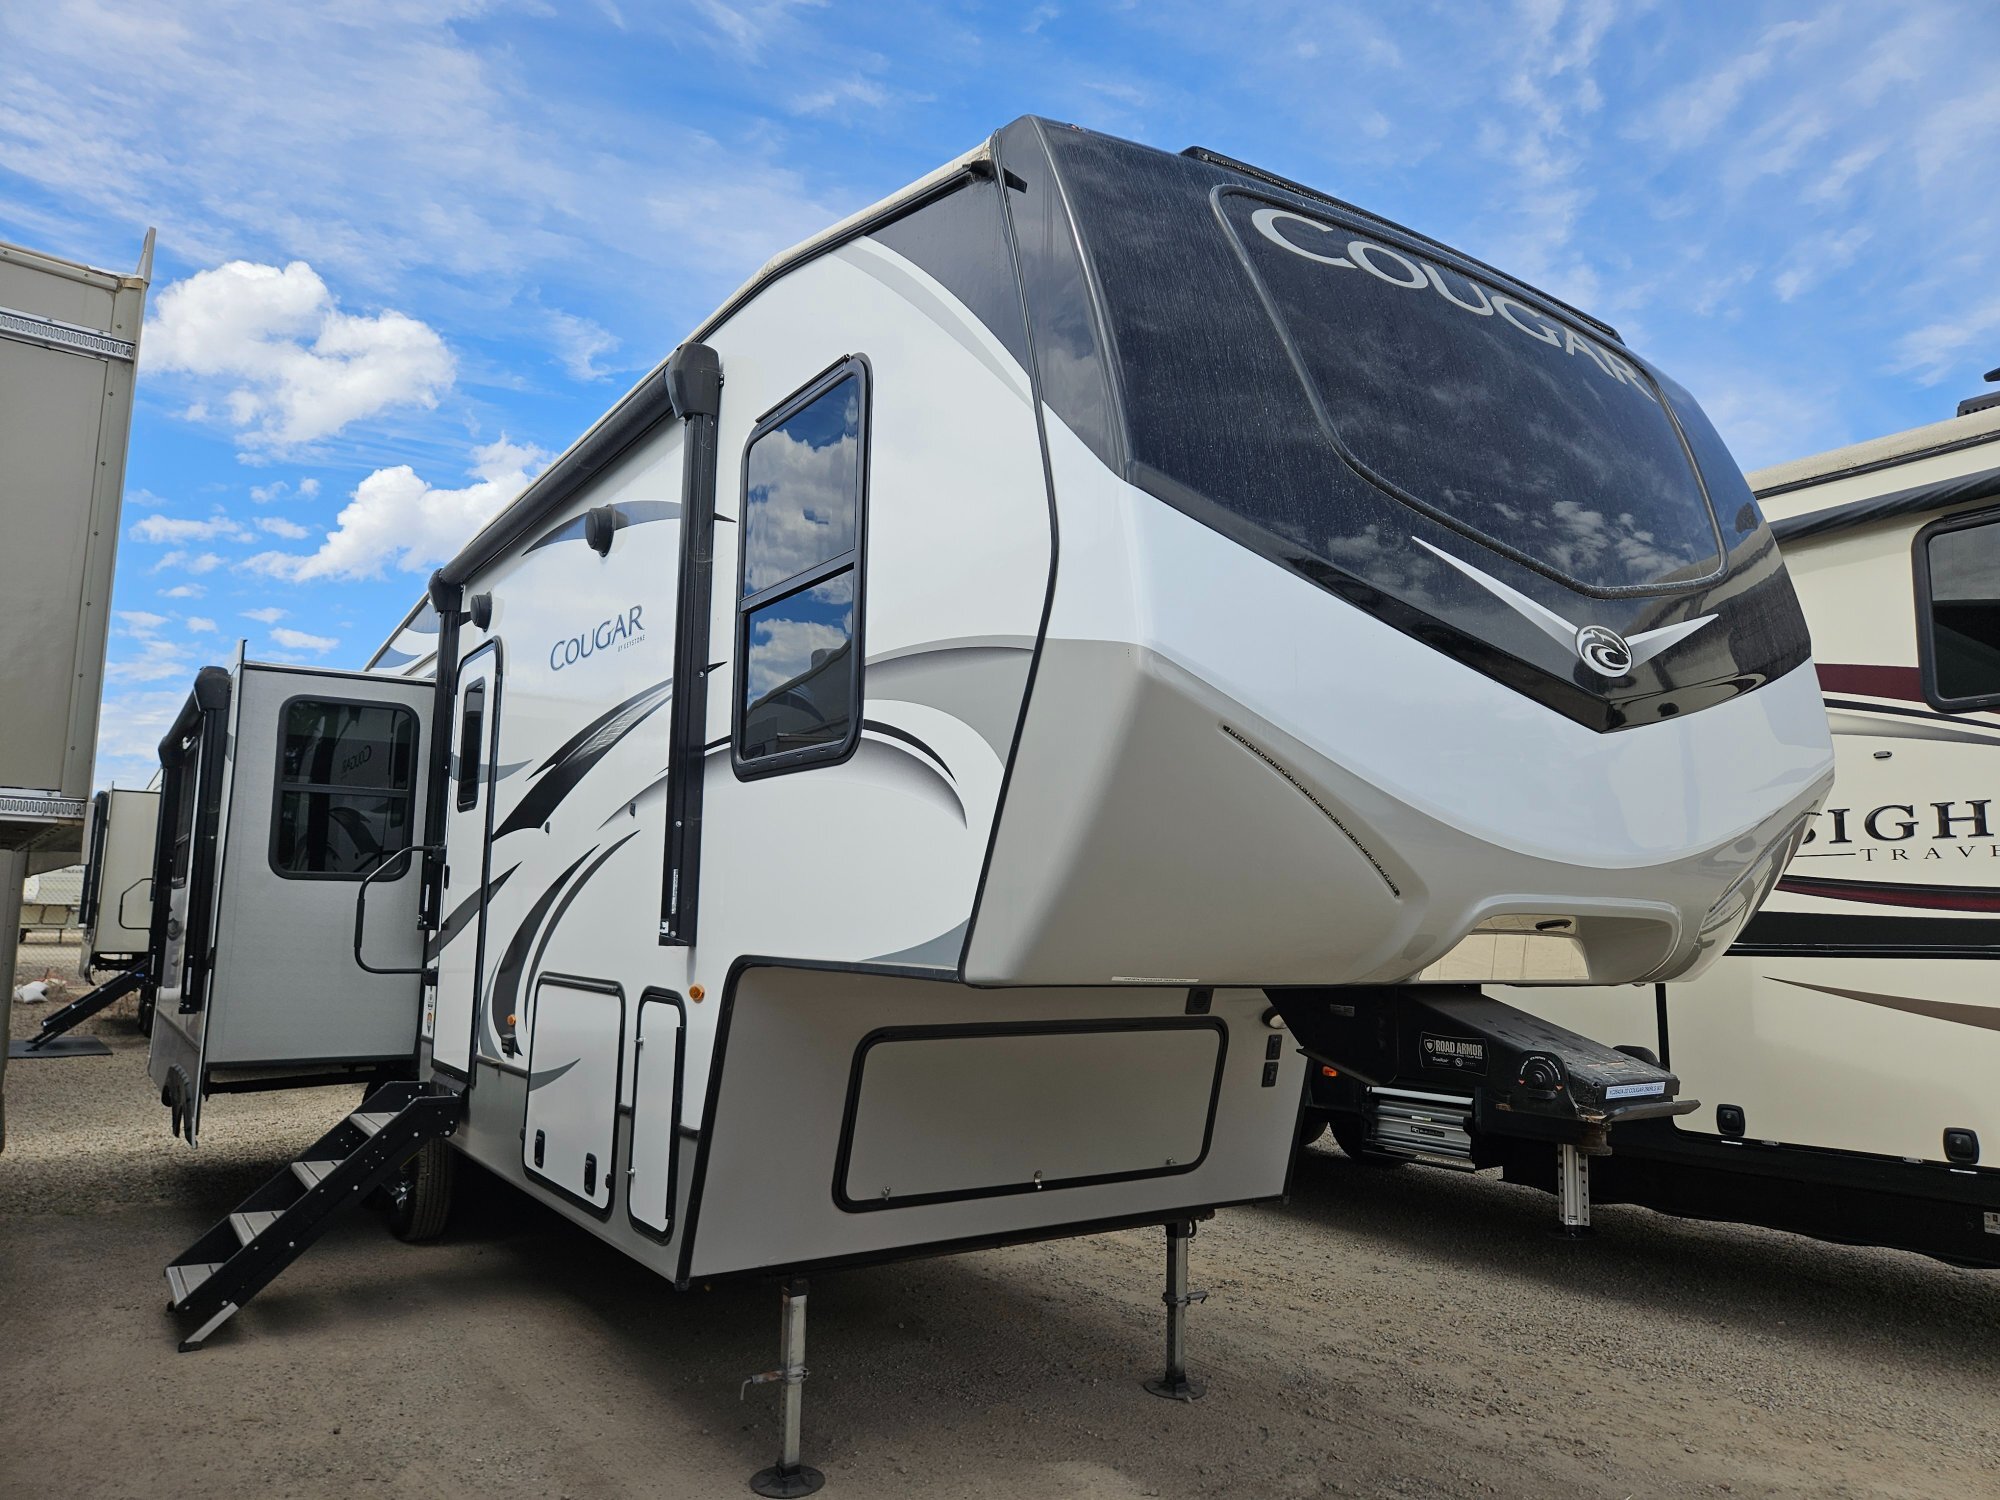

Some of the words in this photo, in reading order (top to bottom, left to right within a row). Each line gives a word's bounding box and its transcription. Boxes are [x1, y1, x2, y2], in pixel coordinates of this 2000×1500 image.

[1251, 208, 1657, 403] COUGAR
[550, 604, 646, 671] COUGAR
[623, 634, 646, 649] KEYSTONE
[1435, 1039, 1456, 1053] ROAD
[1456, 1042, 1483, 1057] ARMOR
